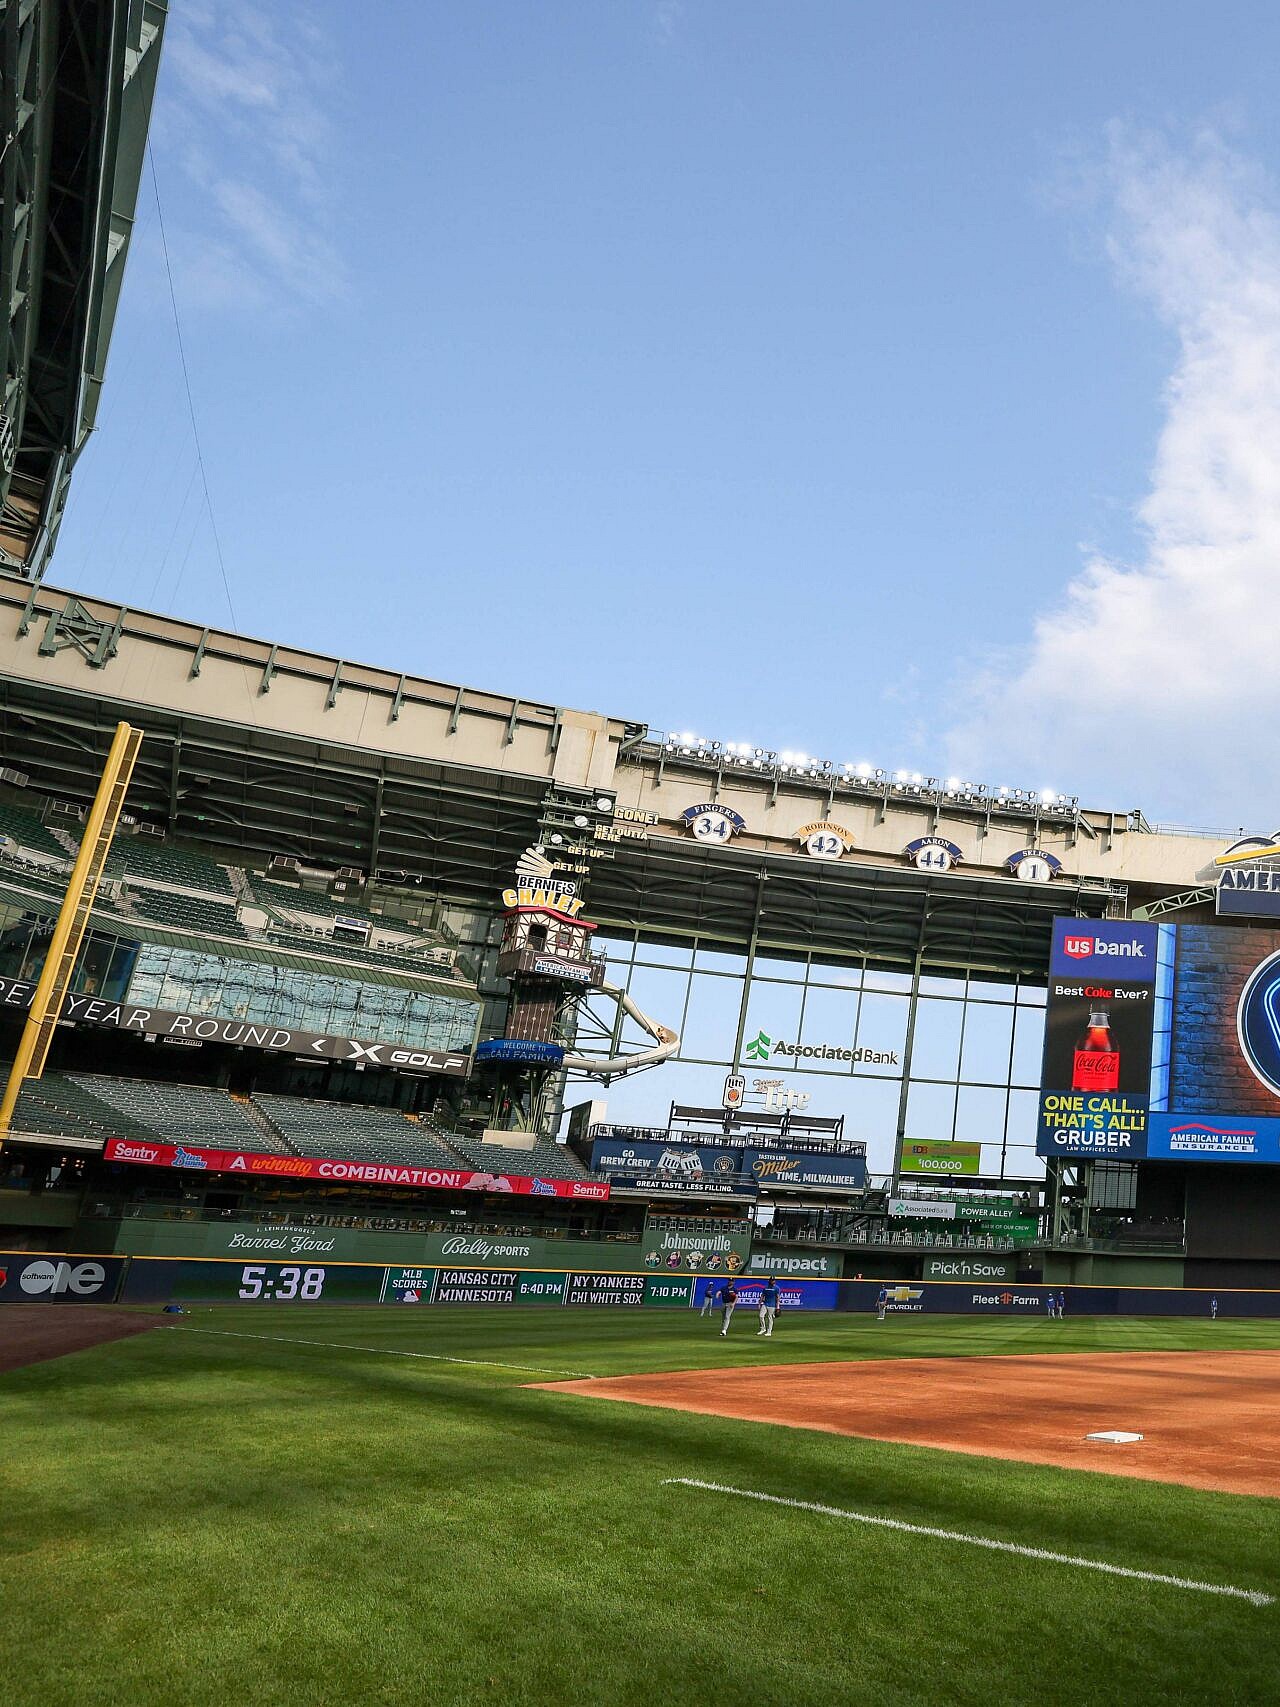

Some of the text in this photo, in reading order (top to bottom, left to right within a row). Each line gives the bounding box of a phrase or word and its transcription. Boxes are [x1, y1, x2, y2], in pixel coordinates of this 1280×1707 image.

[614, 808, 660, 825] GONE!
[695, 804, 737, 820] FINGERS
[596, 825, 648, 840] GET OUTTA
[698, 817, 728, 839] 34
[804, 822, 850, 838] ROBINSON
[594, 831, 621, 843] HERE
[811, 835, 838, 854] 42
[920, 837, 951, 849] AARON
[568, 845, 604, 859] GET UP
[919, 850, 946, 869] 44
[1022, 849, 1048, 860] SELIG
[553, 861, 590, 874] GET UP
[1028, 863, 1039, 879] 1
[517, 875, 576, 894] BERNIE'S
[502, 888, 585, 916] CHALET
[1067, 938, 1144, 957] us bank
[1055, 985, 1148, 1000] Best Coke Ever?
[67, 995, 151, 1029] YEAR
[170, 1015, 292, 1048] ROUND
[503, 1042, 536, 1051] WELCOME
[773, 1039, 898, 1066] Associated Bank
[347, 1040, 386, 1063] X
[390, 1050, 464, 1069] GOLF
[512, 1051, 551, 1062] FAMILY
[762, 1085, 812, 1115] Lite
[1045, 1096, 1145, 1114] ONE CALL...
[1043, 1111, 1145, 1131] THAT'S ALL!
[1054, 1130, 1131, 1147] GRUBER
[1171, 1133, 1255, 1145] AMERICAN FAMILY
[114, 1143, 159, 1162] Sentry
[1175, 1143, 1249, 1151] INSURANCE
[600, 1156, 651, 1168] BREW CREW
[752, 1160, 801, 1178] Miller
[918, 1158, 962, 1169] $100,000
[229, 1155, 461, 1186] A winning COMBINATION!
[776, 1171, 855, 1185] TIME, MILWAUKEE
[636, 1180, 660, 1188] GREAT
[661, 1181, 685, 1189] TASTE.
[961, 1207, 1013, 1218] POWER ALLEY
[228, 1233, 335, 1254] Barrel Yard
[441, 1236, 530, 1260] Bally SPORTS
[660, 1232, 731, 1251] Johnsonville
[765, 1252, 828, 1272] impact
[972, 1263, 1006, 1276] Save
[21, 1273, 55, 1281] software
[402, 1269, 422, 1278] MLB
[442, 1272, 518, 1287] KANSAS CITY
[238, 1266, 326, 1300] 5:38
[392, 1279, 429, 1290] SCORES
[520, 1283, 563, 1295] 6:40 PM
[573, 1275, 645, 1289] NY YANKEES
[439, 1288, 514, 1303] MINNESOTA
[570, 1291, 644, 1305] CHI WHITE SOX
[651, 1286, 688, 1298] 7:10 PM
[972, 1295, 1039, 1305] Fleet Farm
